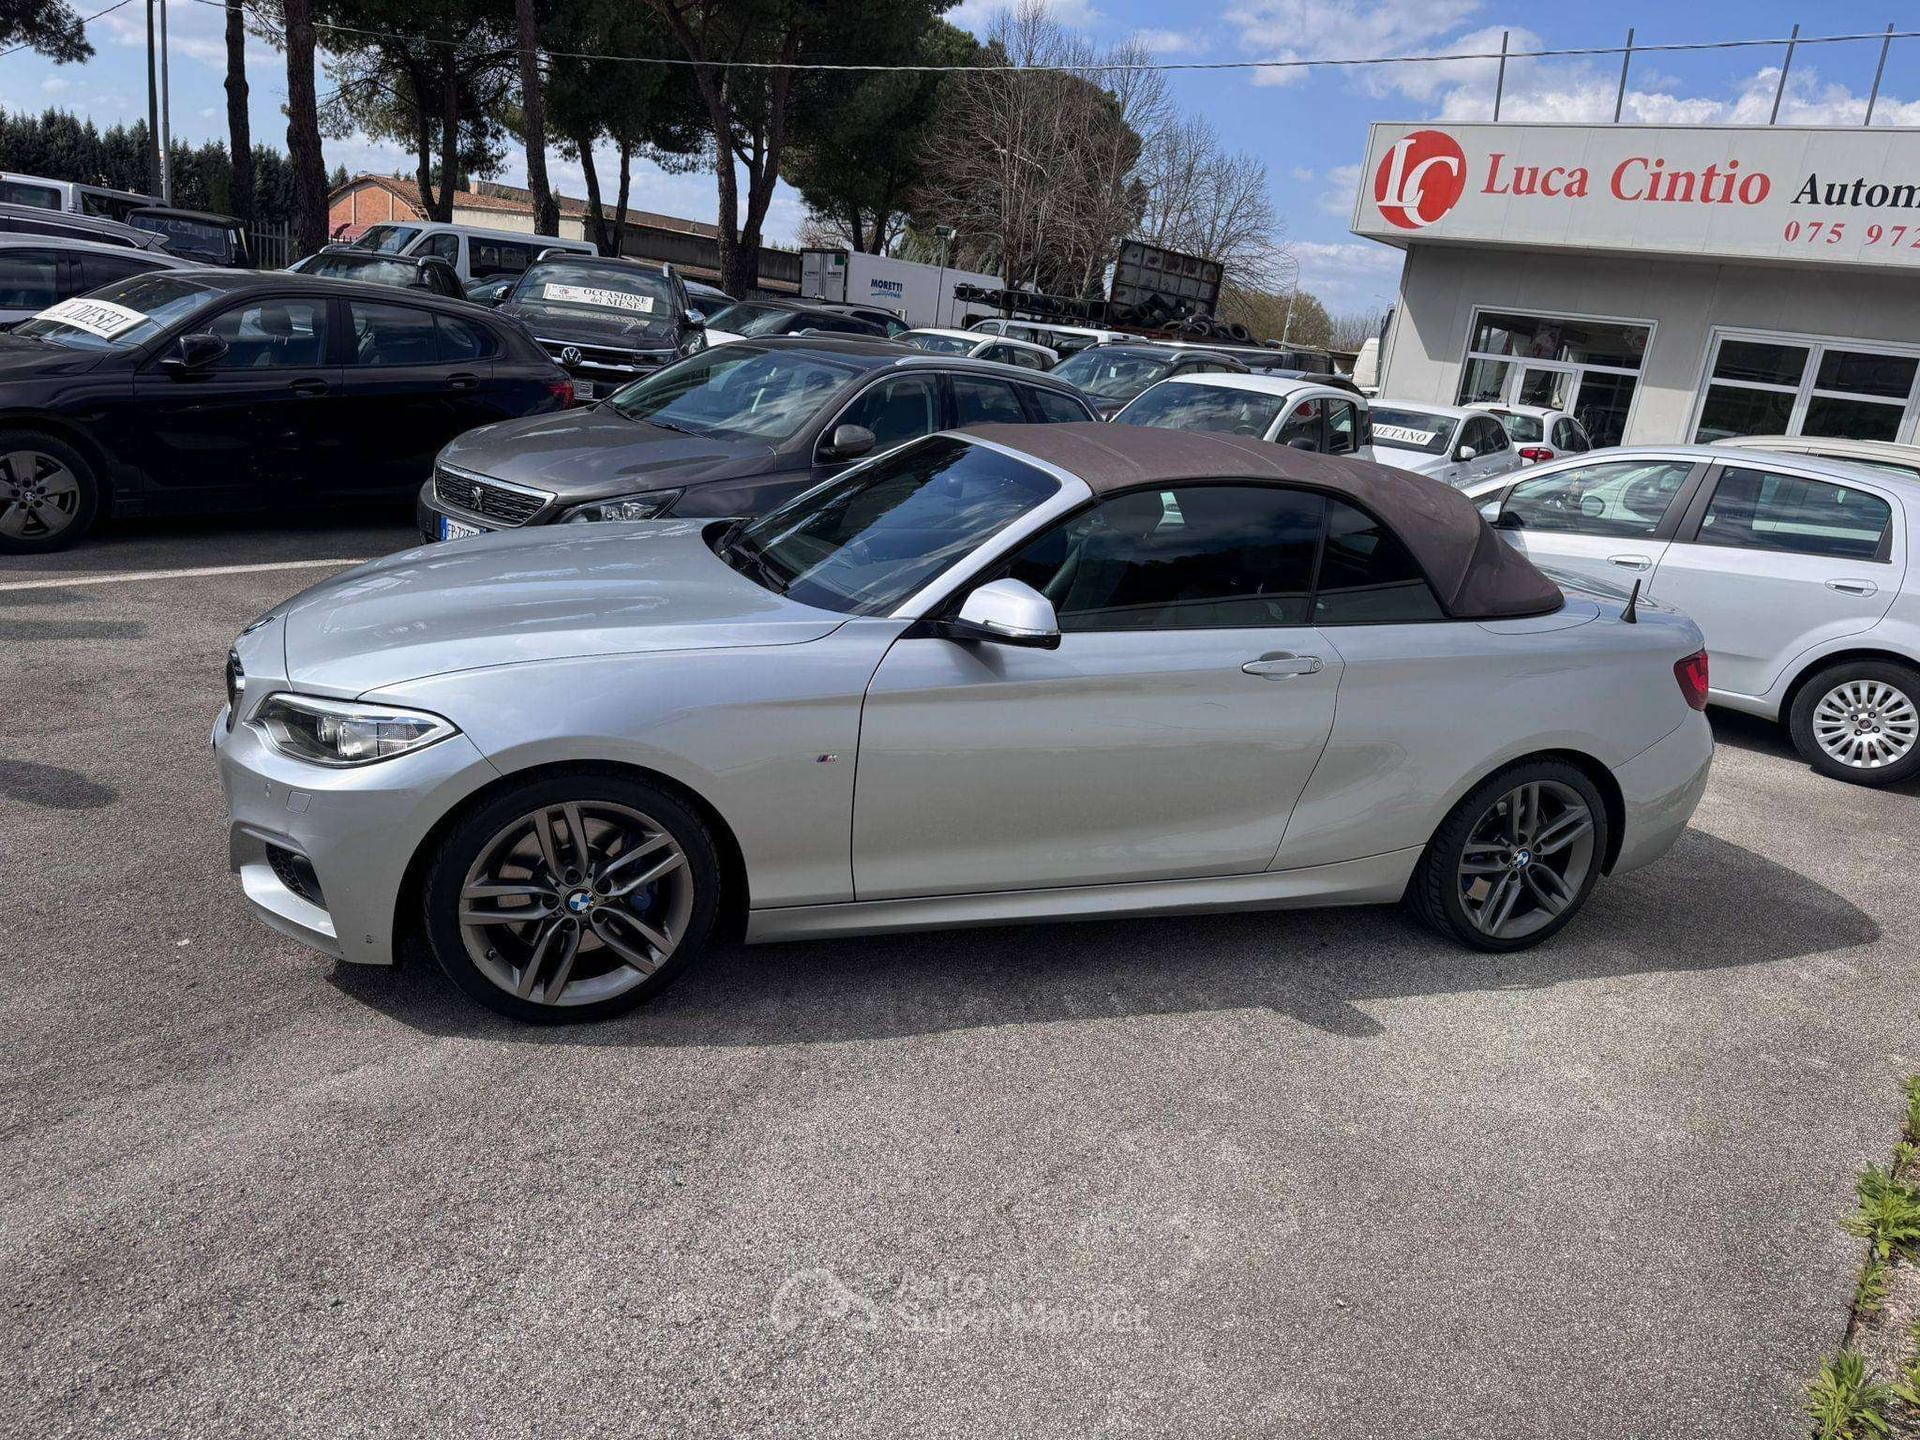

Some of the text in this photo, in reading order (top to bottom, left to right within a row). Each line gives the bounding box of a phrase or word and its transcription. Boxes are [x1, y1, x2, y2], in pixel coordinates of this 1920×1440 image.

[1480, 153, 1920, 209] Luca Cintio Autom
[1784, 220, 1845, 244] 075
[871, 278, 903, 292] MORETTI
[583, 288, 648, 305] OCCASIONE
[607, 297, 641, 310] MESE
[63, 304, 131, 333] DIESEL
[1372, 425, 1427, 443] METANO
